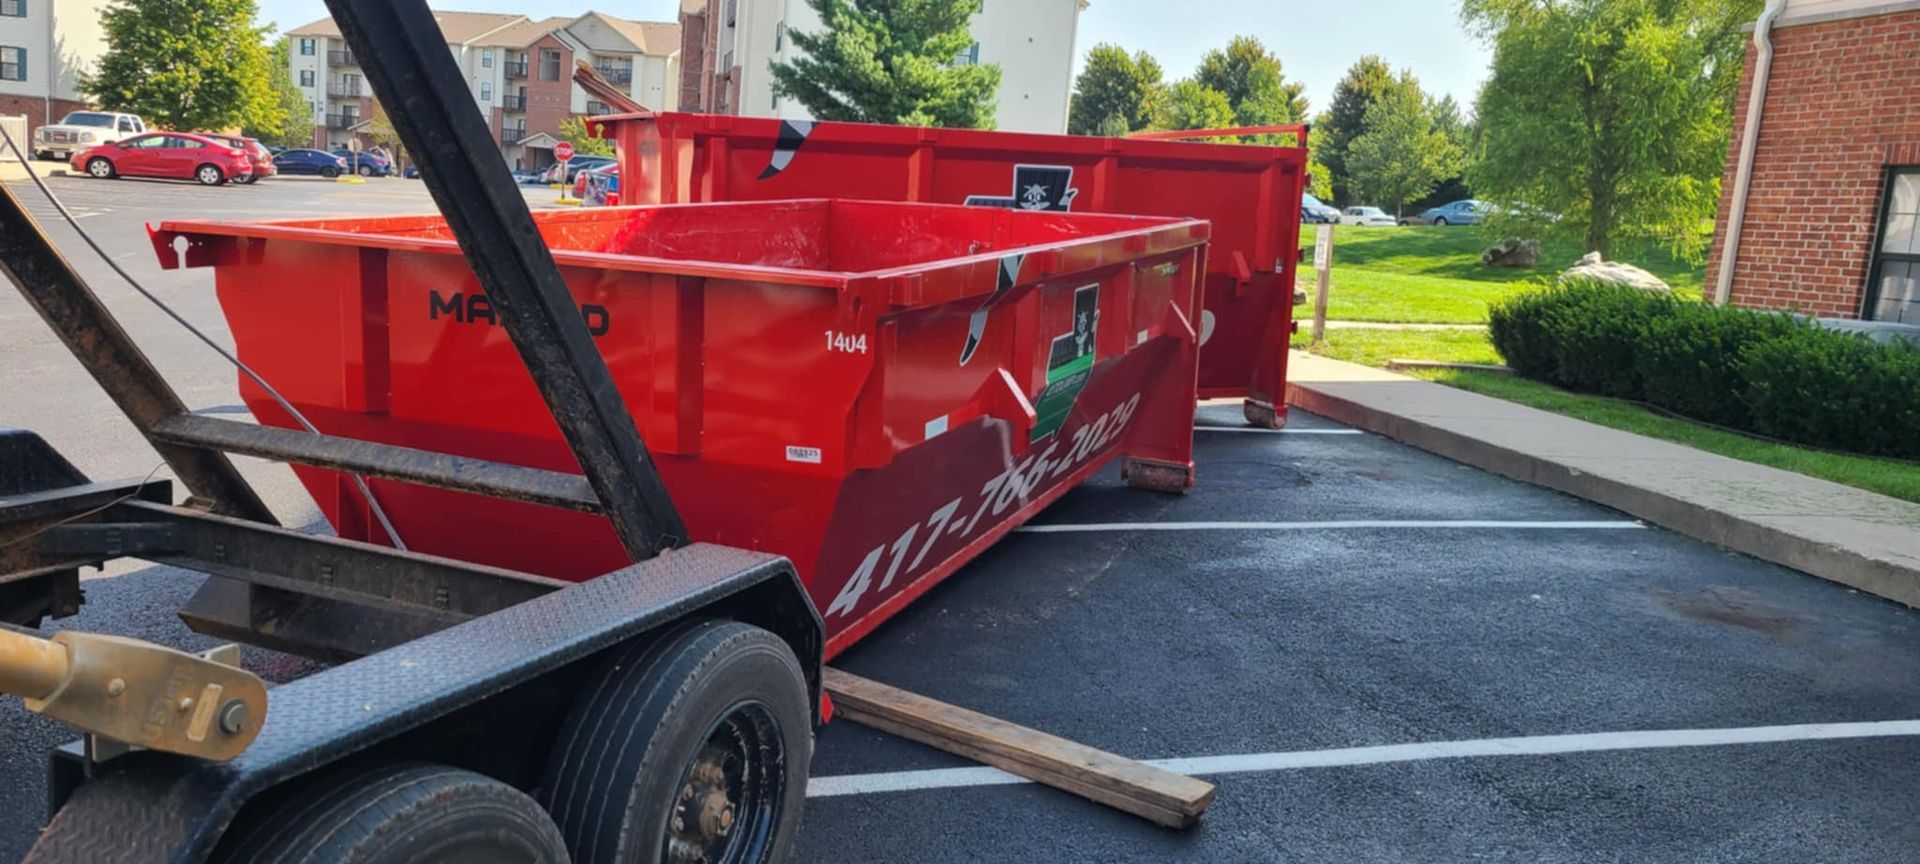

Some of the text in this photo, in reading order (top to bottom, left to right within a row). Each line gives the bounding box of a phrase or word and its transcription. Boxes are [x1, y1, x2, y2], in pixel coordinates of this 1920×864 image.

[556, 147, 572, 155] STOP
[429, 289, 610, 337] MAD
[825, 330, 868, 354] 1404
[824, 392, 1141, 618] 417-766-2029
